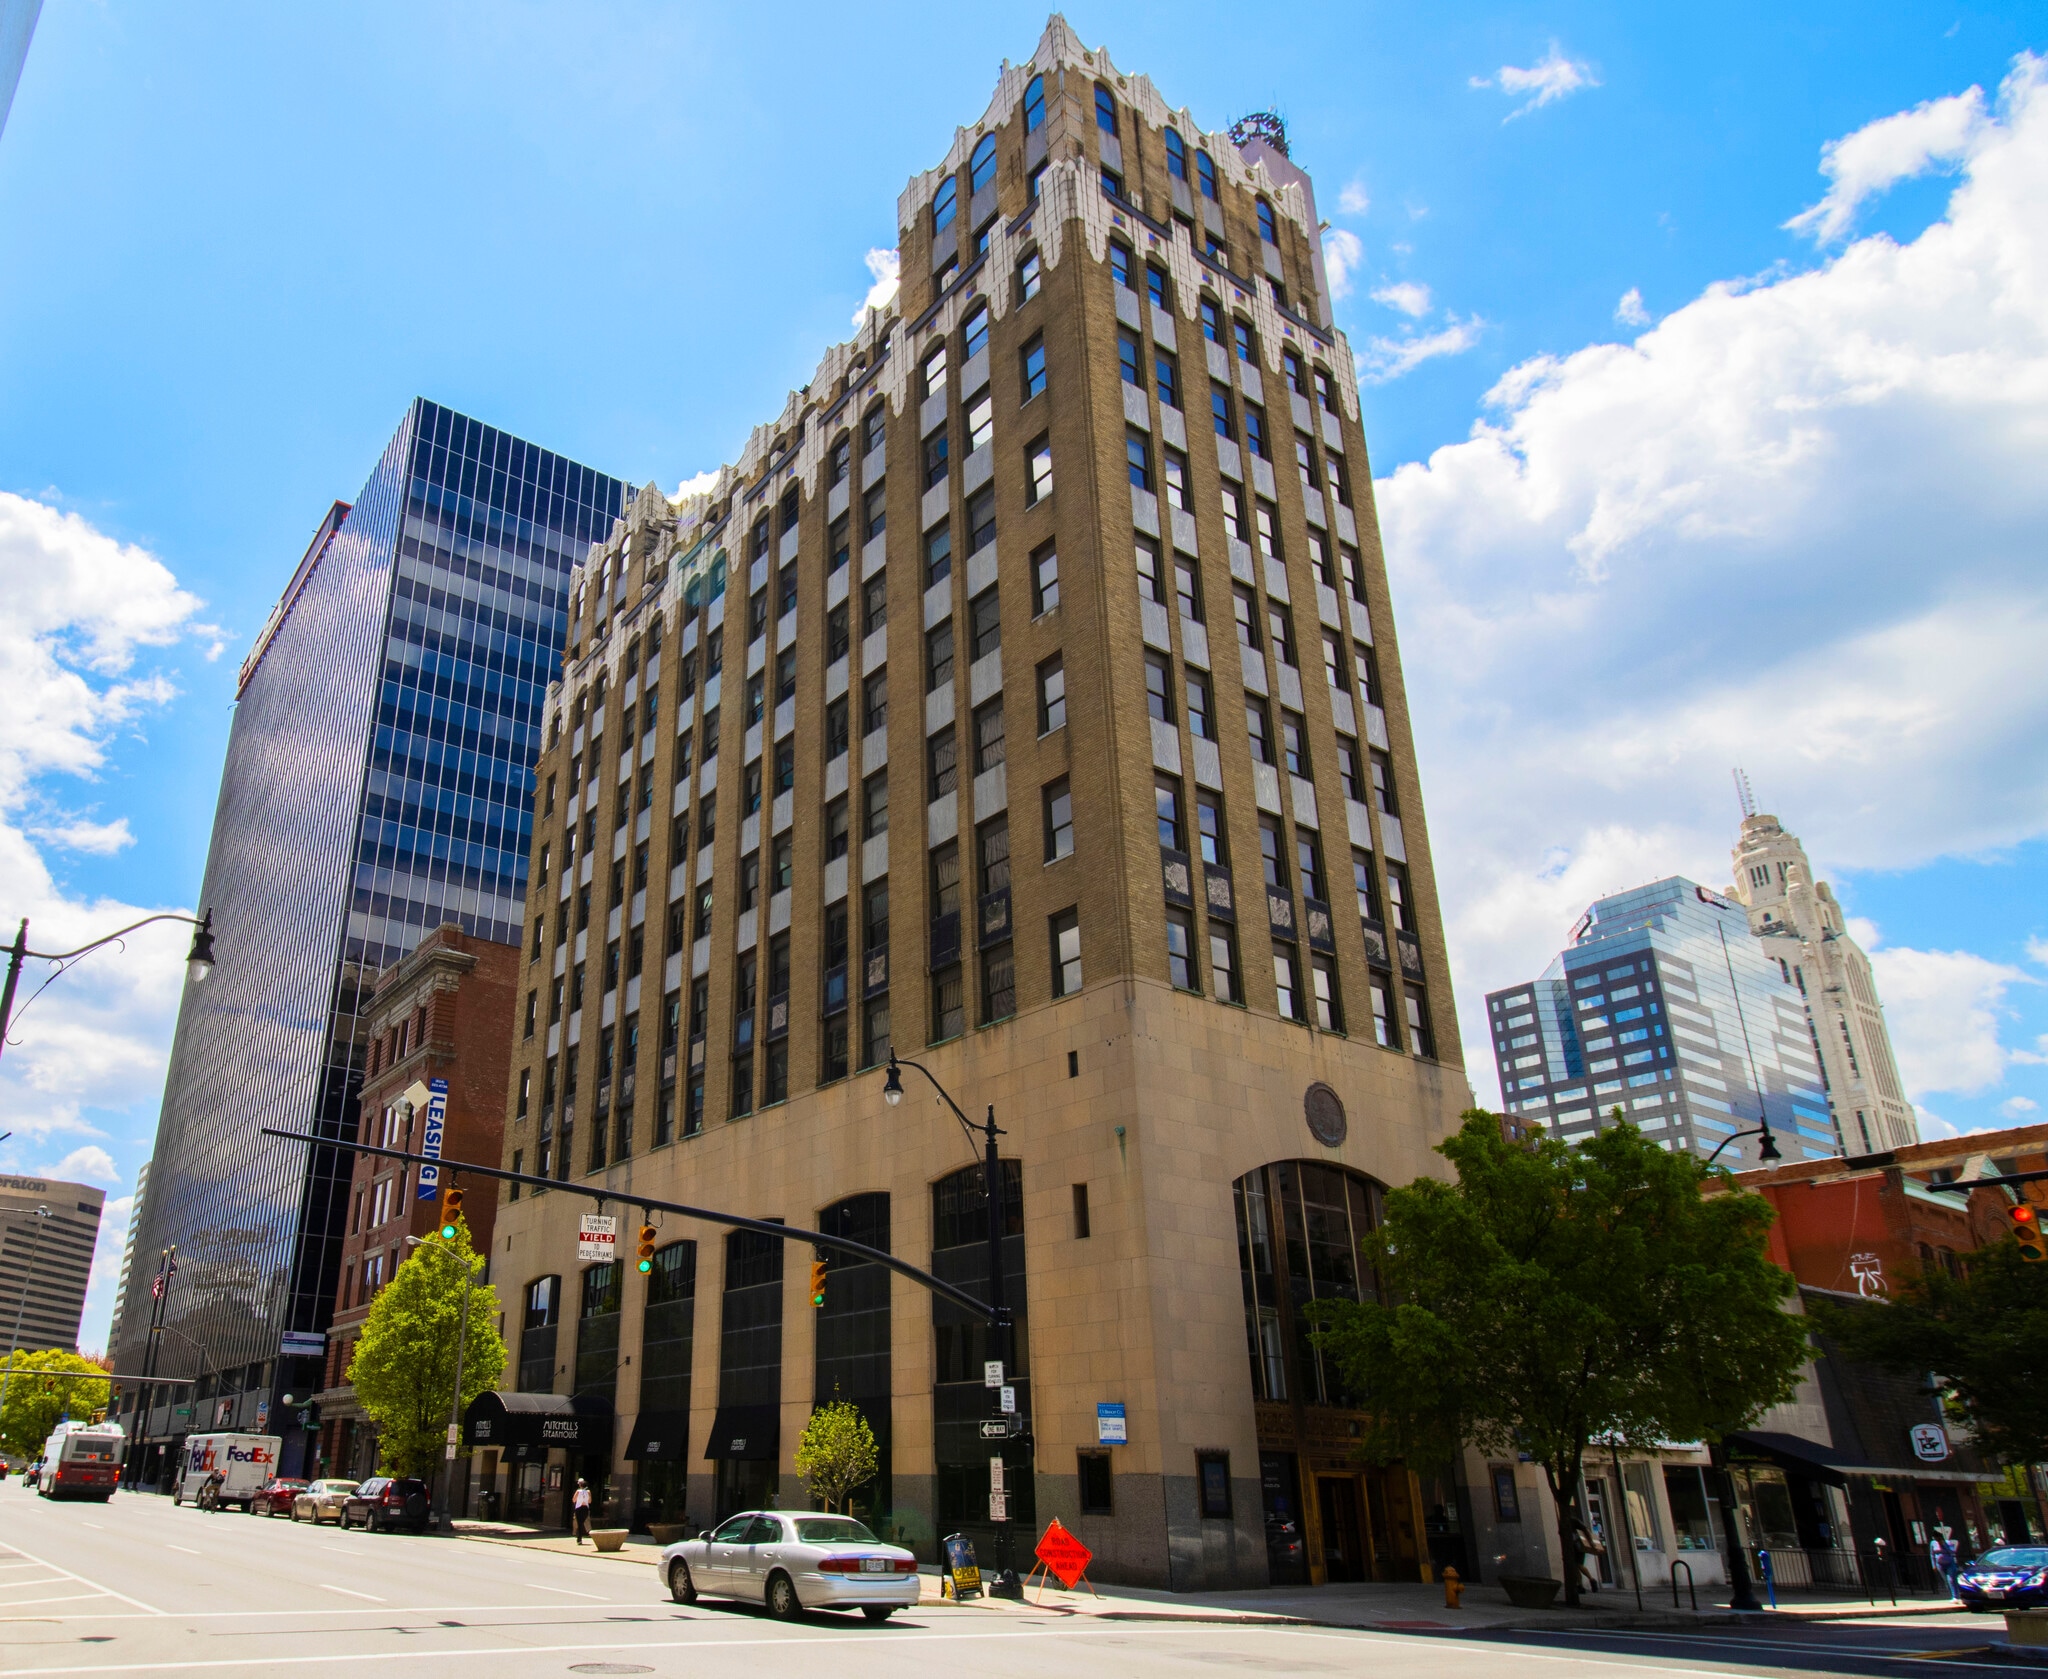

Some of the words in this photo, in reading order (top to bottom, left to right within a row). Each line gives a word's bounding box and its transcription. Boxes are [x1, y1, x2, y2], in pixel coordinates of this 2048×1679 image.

[0, 1178, 47, 1192] raton
[587, 1218, 612, 1226] TURNING
[587, 1225, 610, 1233] TRAFFIC
[583, 1233, 613, 1242] YIELD
[580, 1250, 612, 1258] PEDESTRIANS
[226, 1446, 274, 1463] FedEx
[1051, 1537, 1070, 1546] ROAD
[1039, 1549, 1088, 1558] CONSTRUCTION
[1056, 1562, 1077, 1570] AHEAD
[954, 1566, 977, 1577] OPEN
